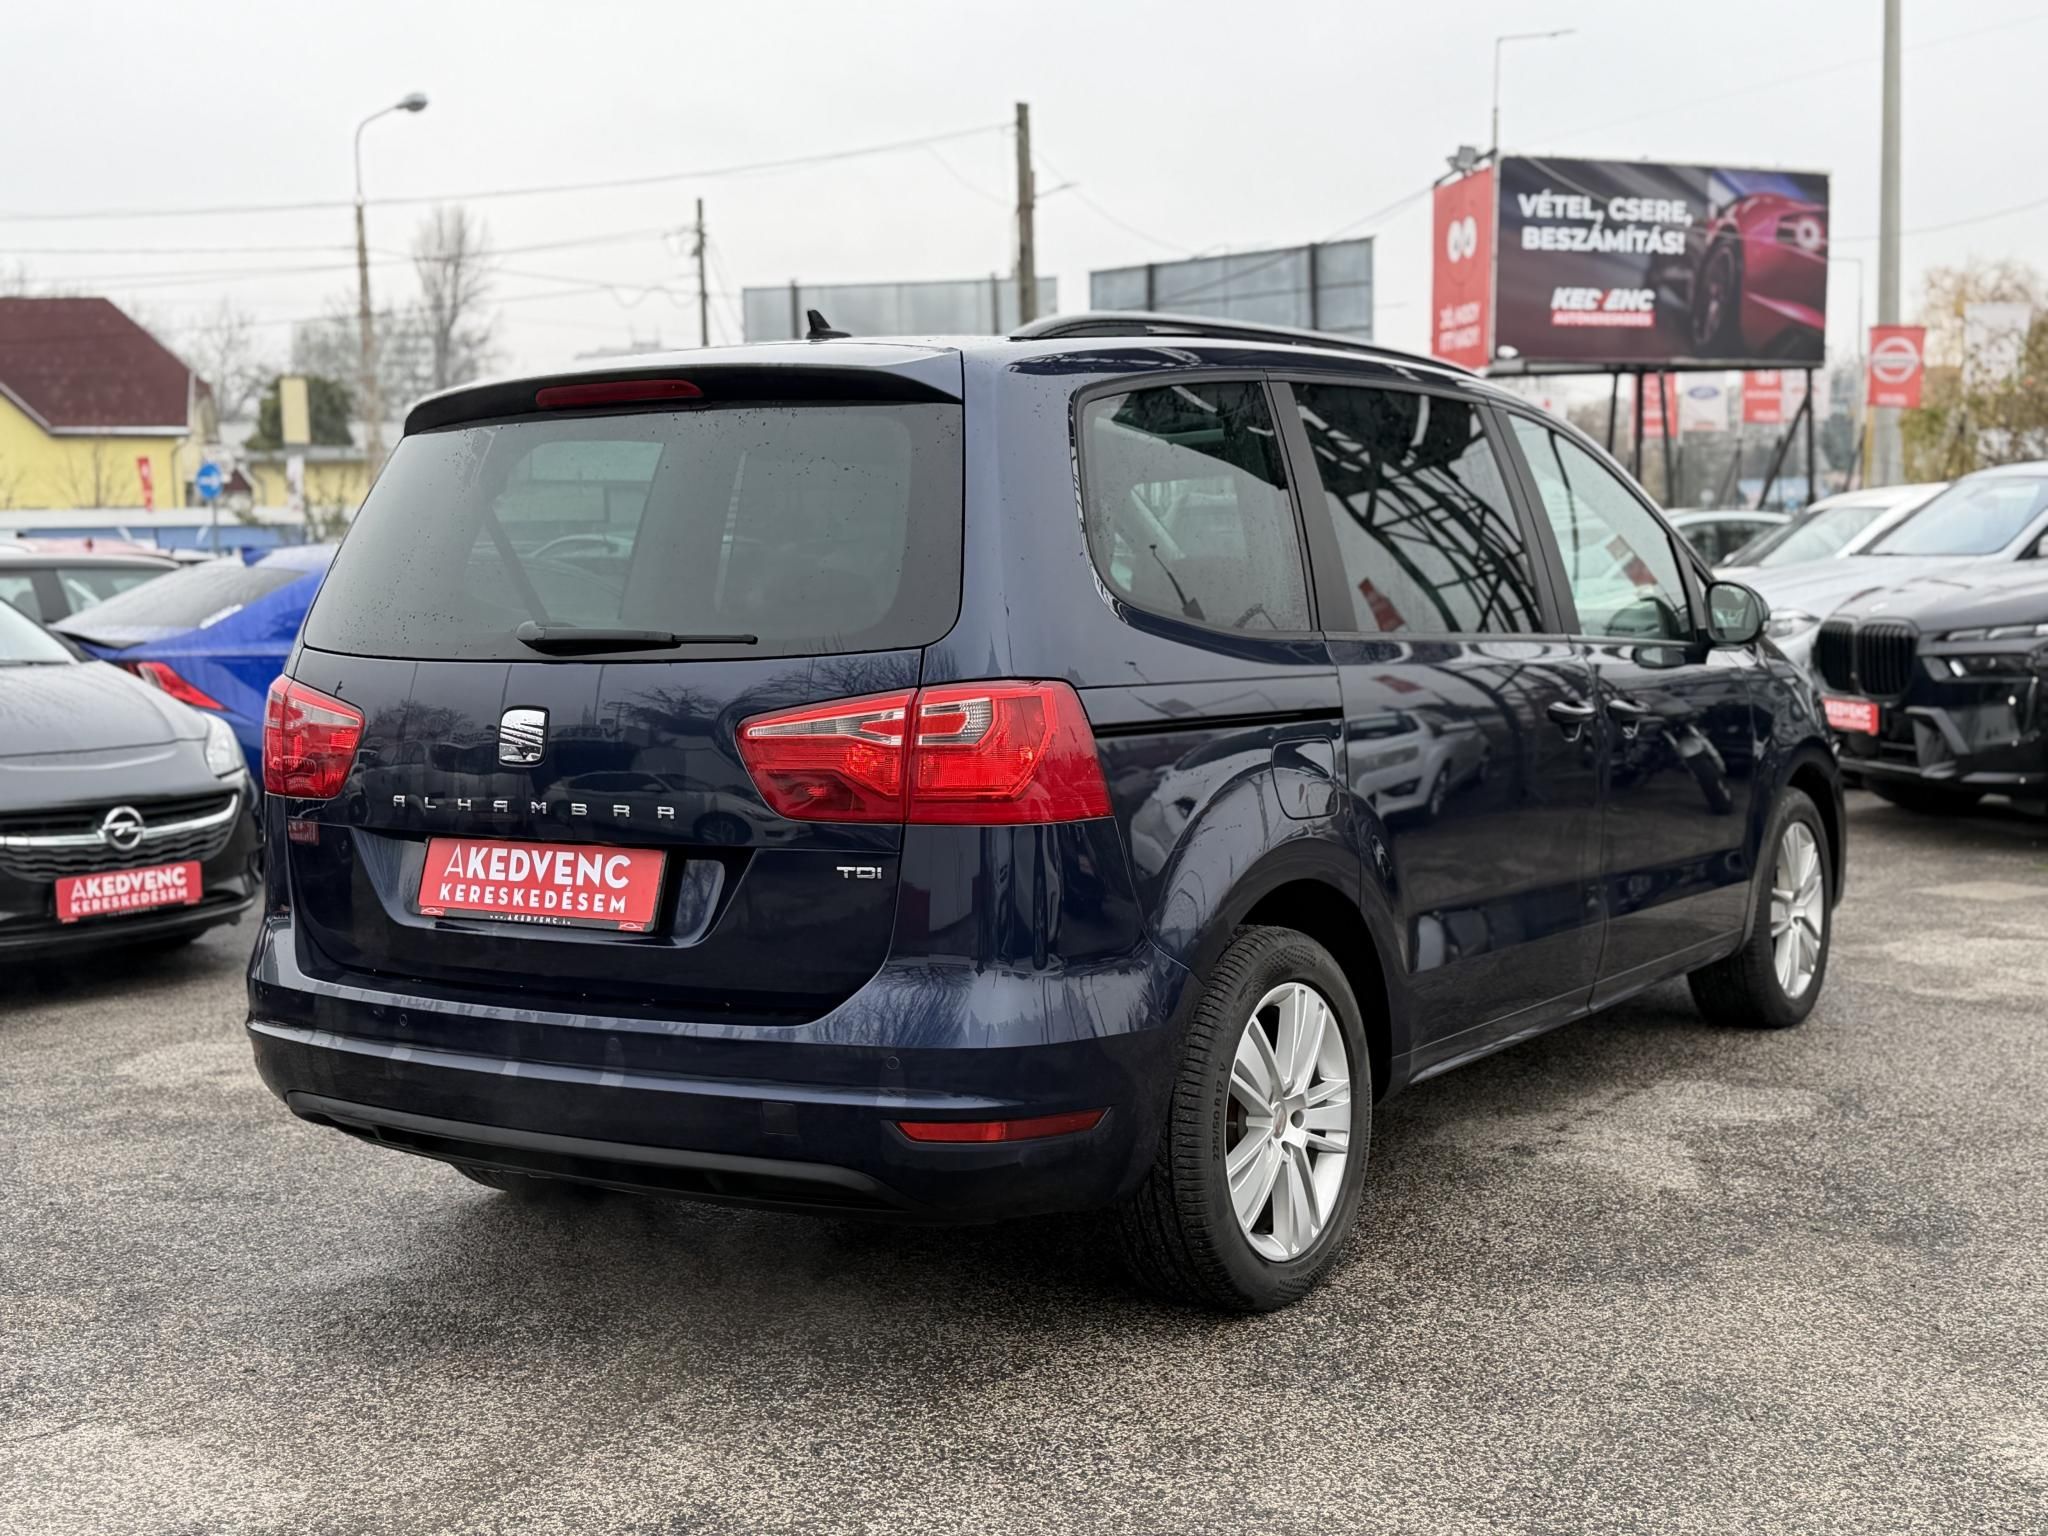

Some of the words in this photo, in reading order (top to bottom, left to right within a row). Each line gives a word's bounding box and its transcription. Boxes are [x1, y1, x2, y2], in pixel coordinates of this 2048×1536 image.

[1517, 188, 1604, 224] VÉTEL,
[1608, 196, 1693, 228] CSERE,
[1521, 223, 1686, 255] BESZÁMÍTÁS!
[392, 794, 675, 820] ALHAMBRA
[836, 866, 882, 879] TDI
[439, 882, 627, 914] KERESKEDÉSEM
[1215, 1080, 1224, 1095] 17
[1211, 1110, 1221, 1161] 225/50
